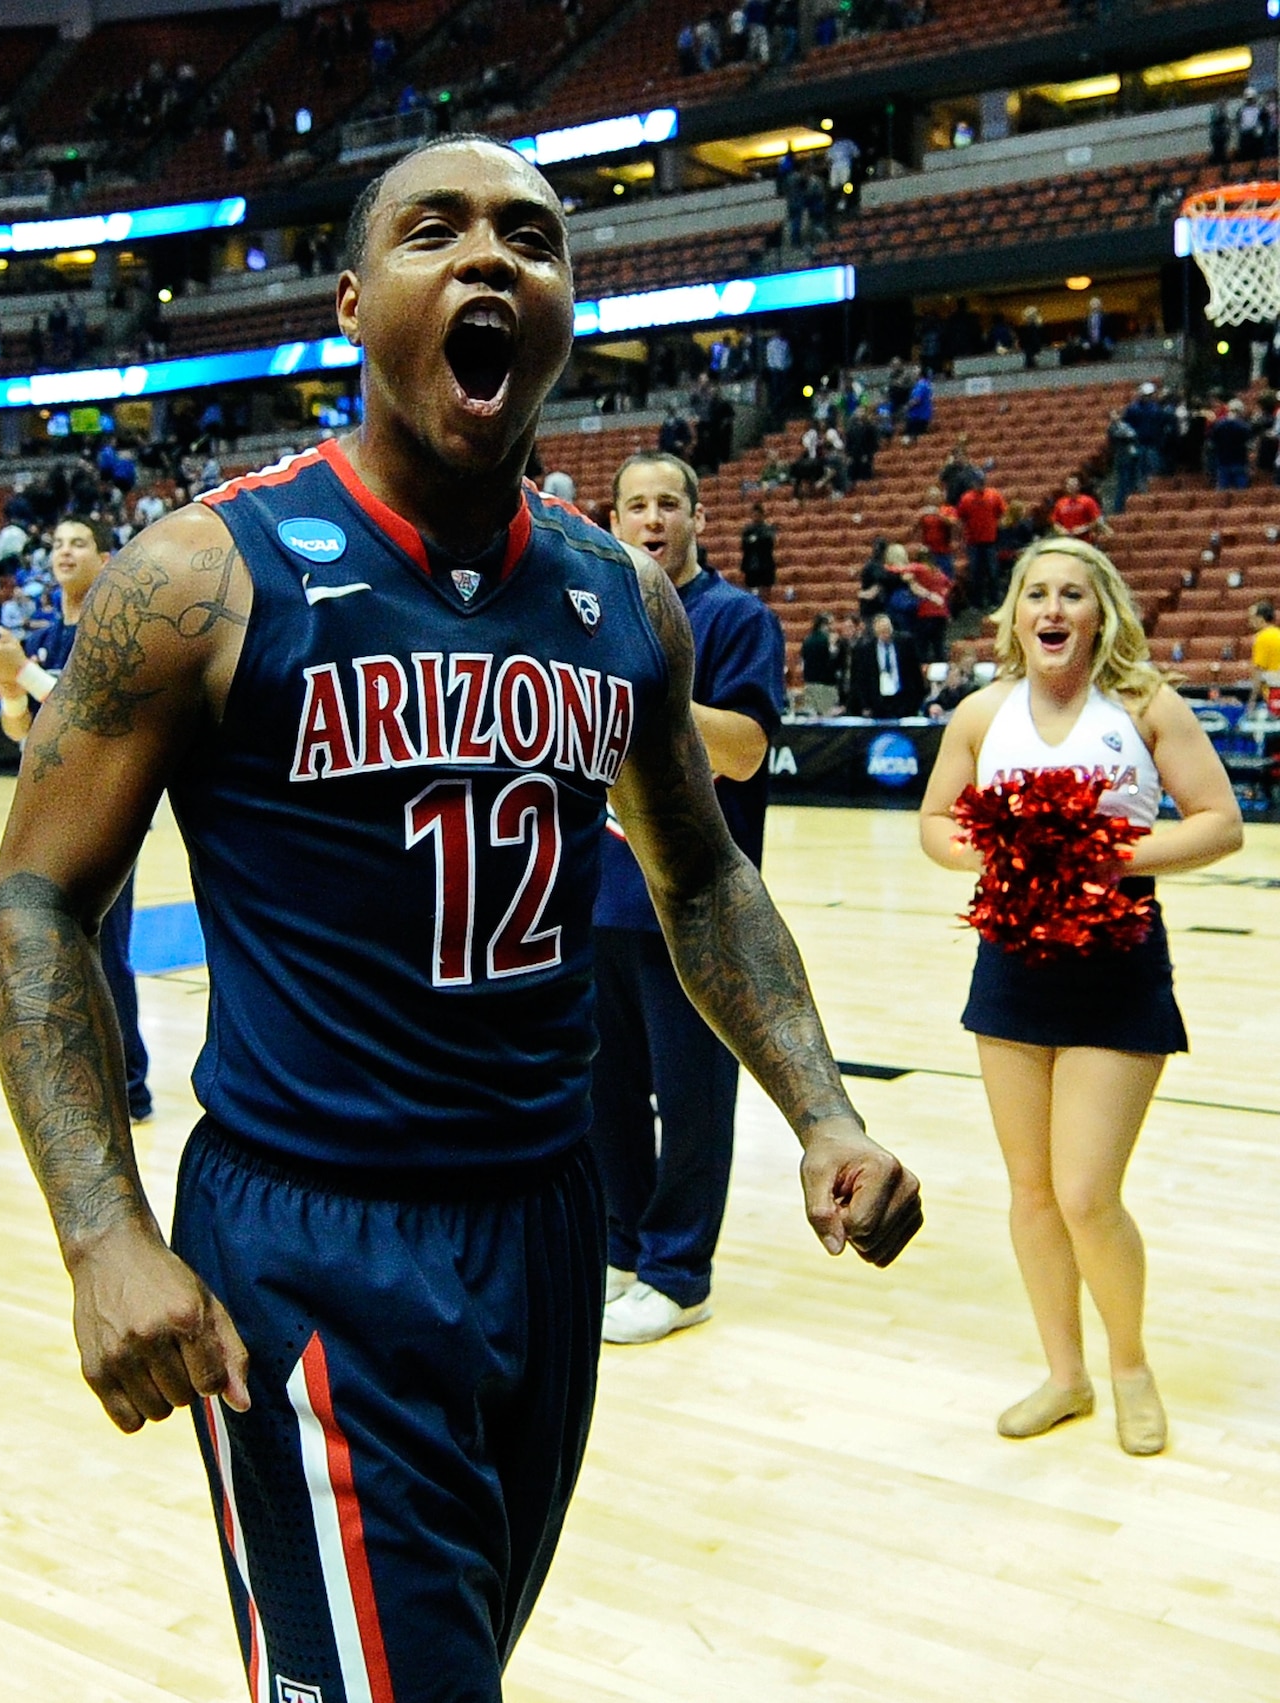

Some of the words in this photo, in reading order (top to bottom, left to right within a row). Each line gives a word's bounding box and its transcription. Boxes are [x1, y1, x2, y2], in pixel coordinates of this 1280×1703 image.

[289, 536, 340, 552] NCAA
[289, 652, 634, 785] ARIZONA
[404, 772, 562, 987] 12
